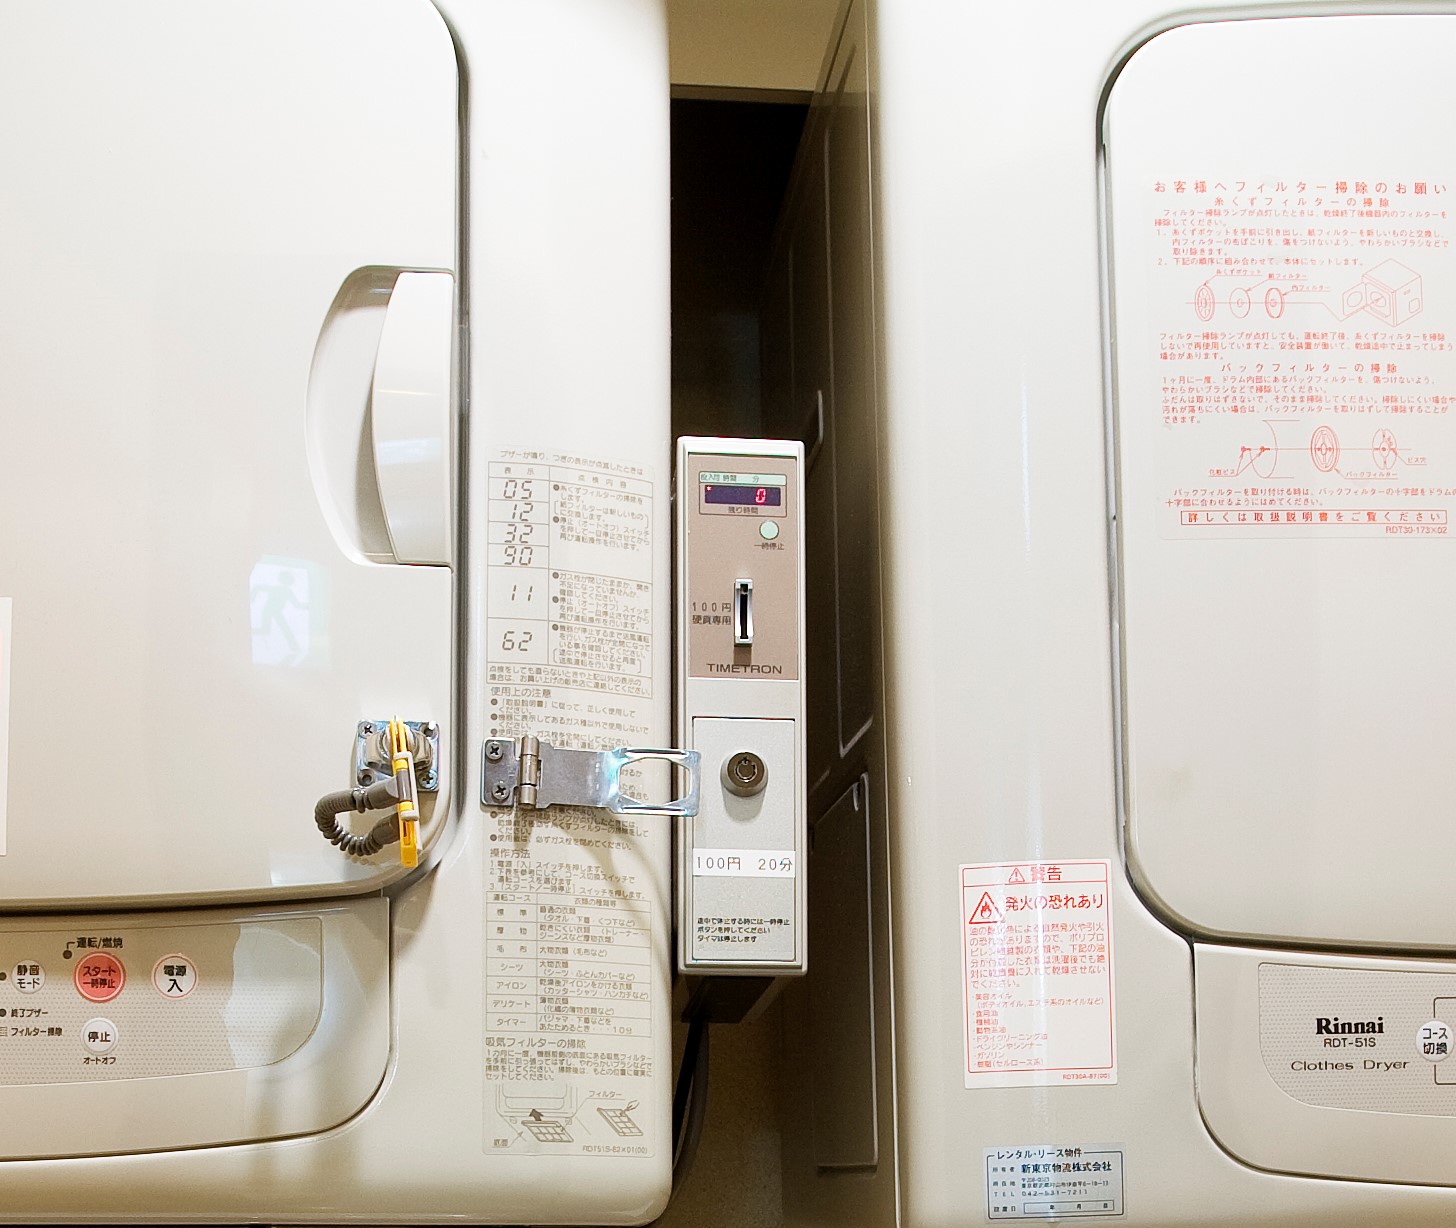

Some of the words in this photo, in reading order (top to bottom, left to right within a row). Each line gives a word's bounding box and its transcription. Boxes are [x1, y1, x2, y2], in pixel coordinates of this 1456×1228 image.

[504, 480, 532, 499] 05
[512, 503, 533, 521] 12
[504, 524, 533, 543] 32
[504, 546, 533, 565] 90
[502, 631, 532, 651] 62
[707, 664, 782, 674] TIMETRON
[697, 857, 740, 870] 100円
[759, 858, 792, 871] 20分
[17, 965, 39, 976] 静音
[83, 966, 116, 976] スタート
[164, 965, 187, 976] 電源
[17, 978, 40, 988] モード
[83, 978, 115, 989] 一時停止
[167, 979, 183, 992] 入
[1316, 1017, 1384, 1035] Rinnai
[87, 1031, 111, 1043] 停止
[1423, 1028, 1448, 1040] コース
[1324, 1038, 1376, 1048] RDT-51S
[1423, 1043, 1448, 1054] 切換
[1291, 1061, 1354, 1071] Clothes
[1363, 1060, 1410, 1071] Dryer
[997, 1148, 1082, 1160] レンタル・リース物件
[1021, 1162, 1112, 1173] 新東京物流株式会社
